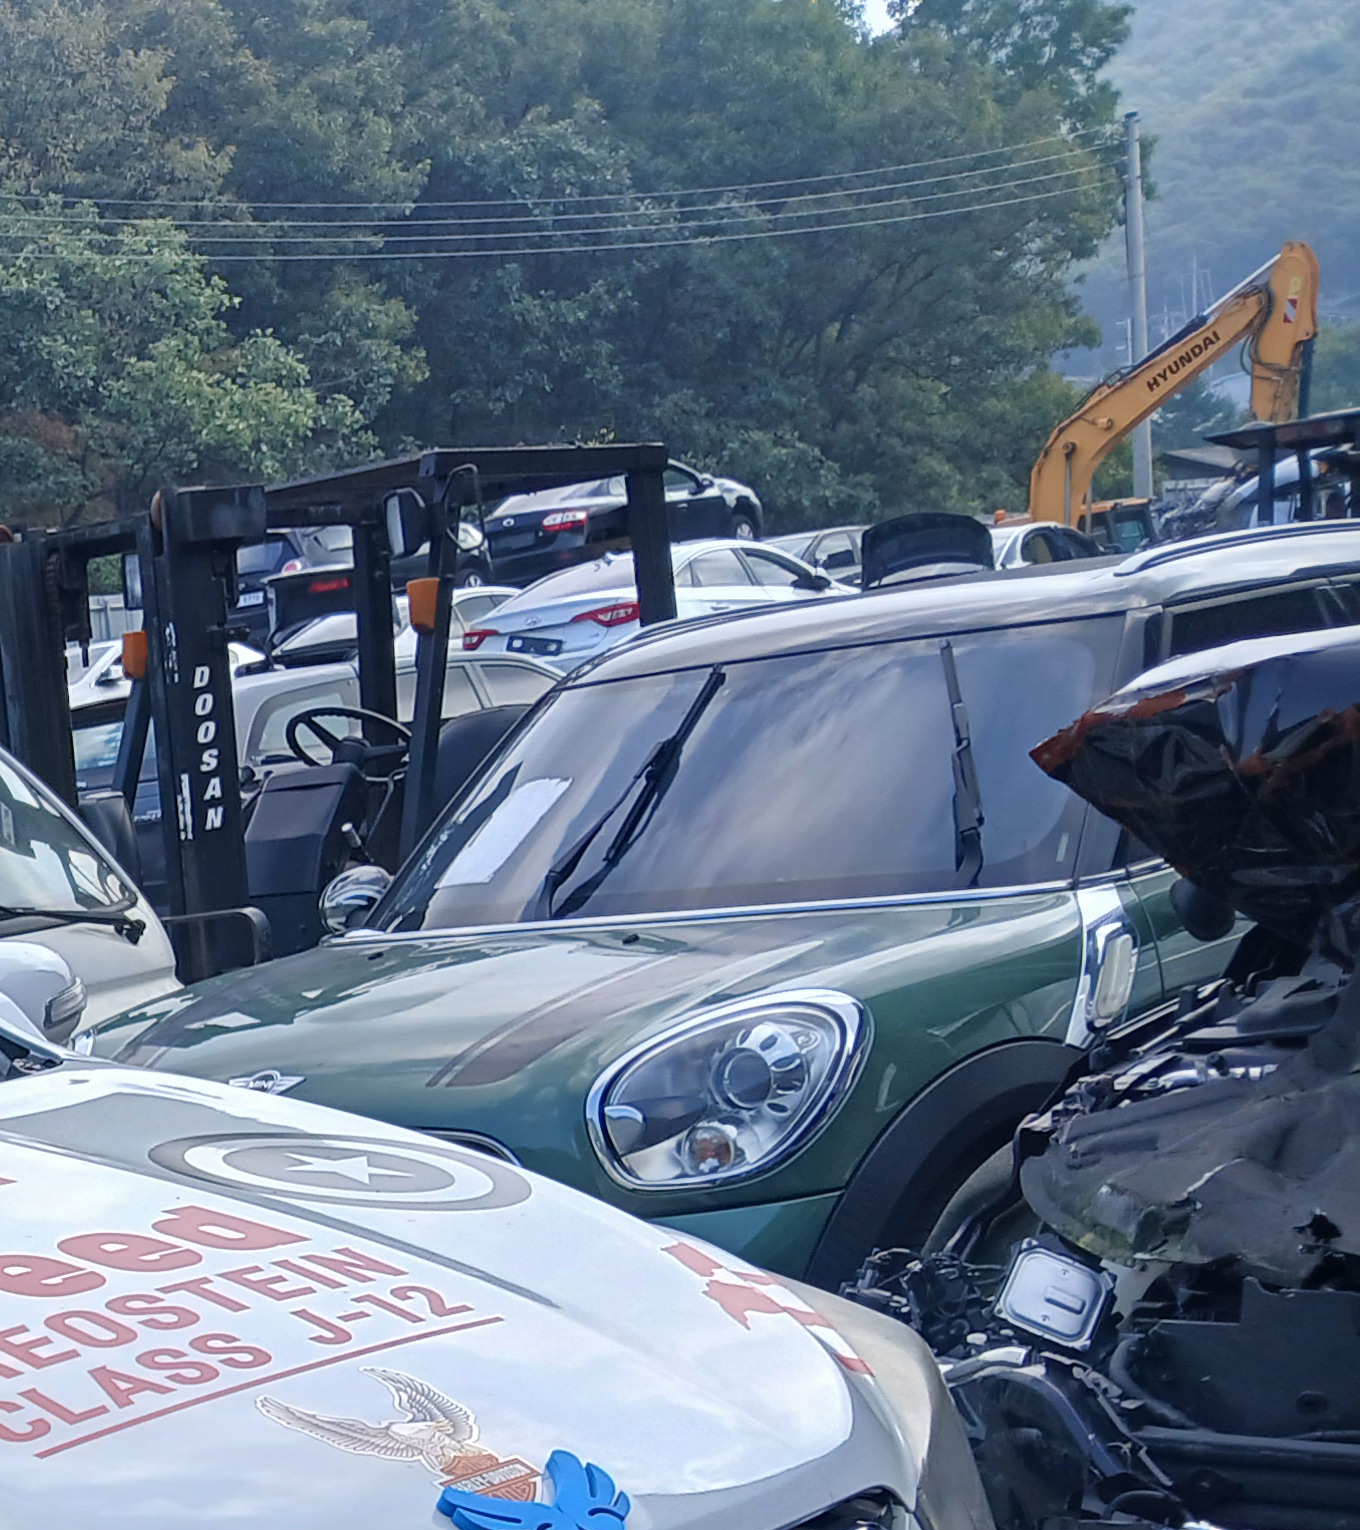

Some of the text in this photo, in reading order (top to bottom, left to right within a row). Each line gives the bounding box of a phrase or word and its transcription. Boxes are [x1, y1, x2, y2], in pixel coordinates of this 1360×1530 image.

[1146, 330, 1221, 392] HYUNDAI
[193, 665, 224, 831] DOOSAN
[288, 1284, 476, 1346] J-12
